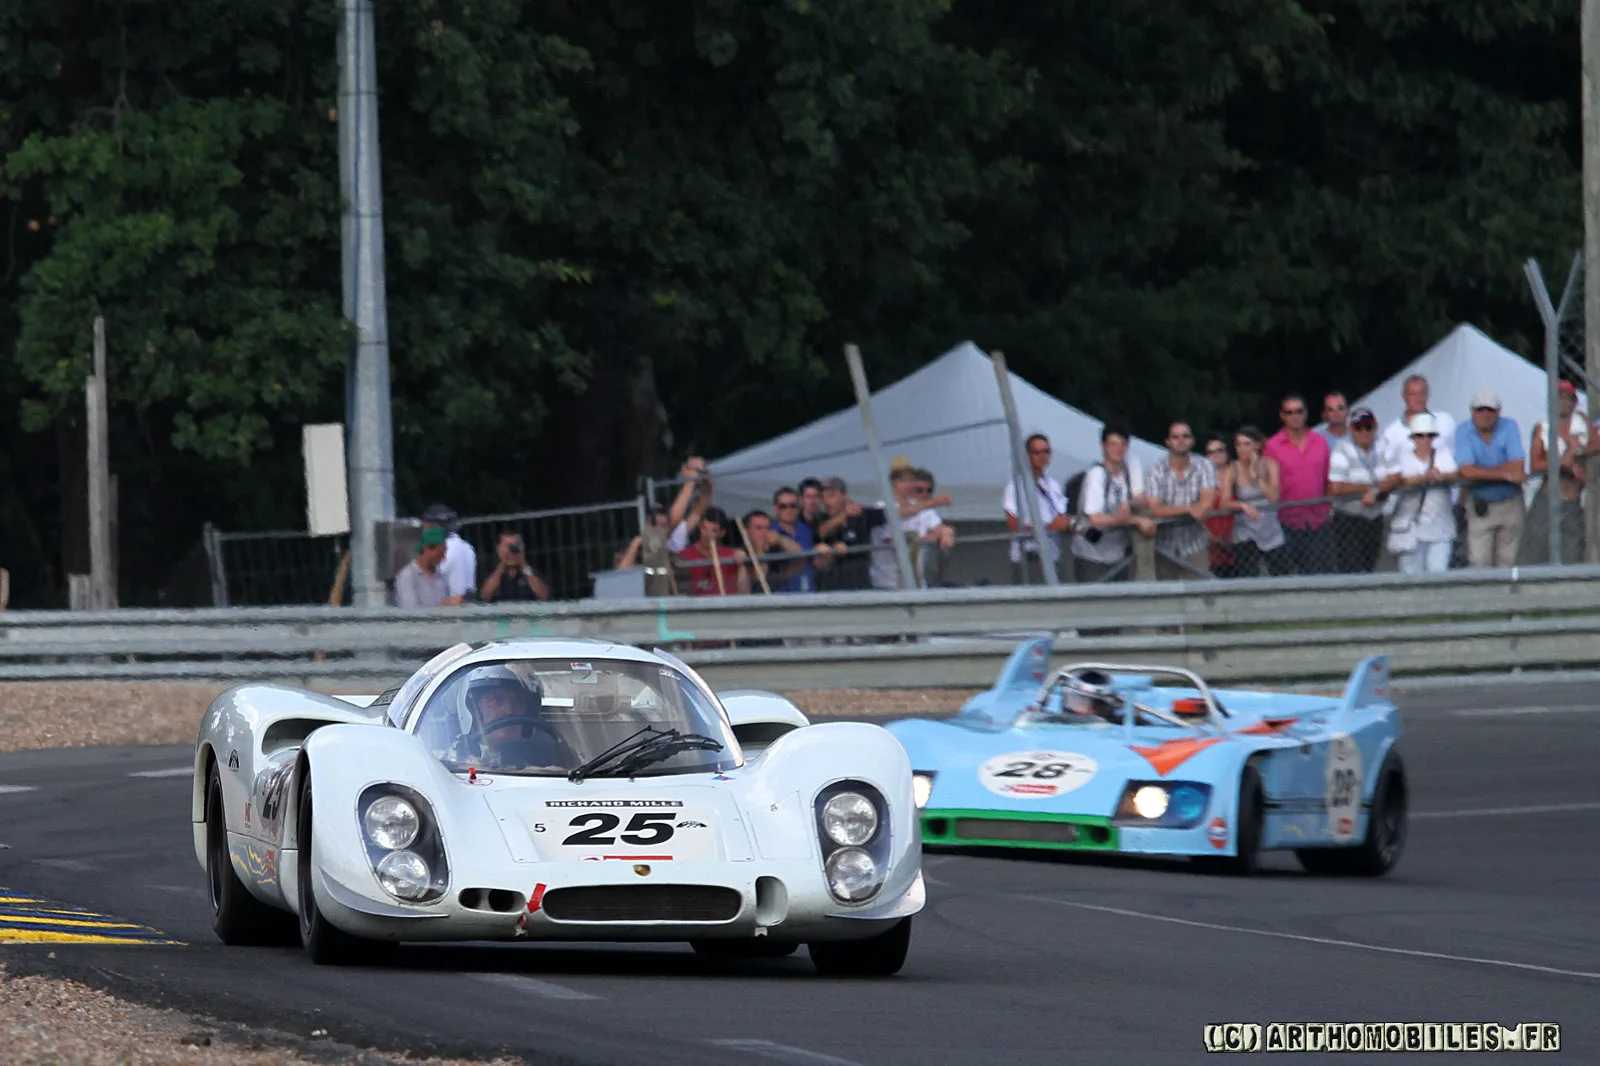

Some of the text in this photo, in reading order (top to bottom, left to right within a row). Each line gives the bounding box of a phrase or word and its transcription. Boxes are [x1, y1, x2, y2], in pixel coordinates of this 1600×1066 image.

[994, 761, 1073, 779] 28
[533, 823, 547, 833] 5
[562, 812, 677, 846] 25
